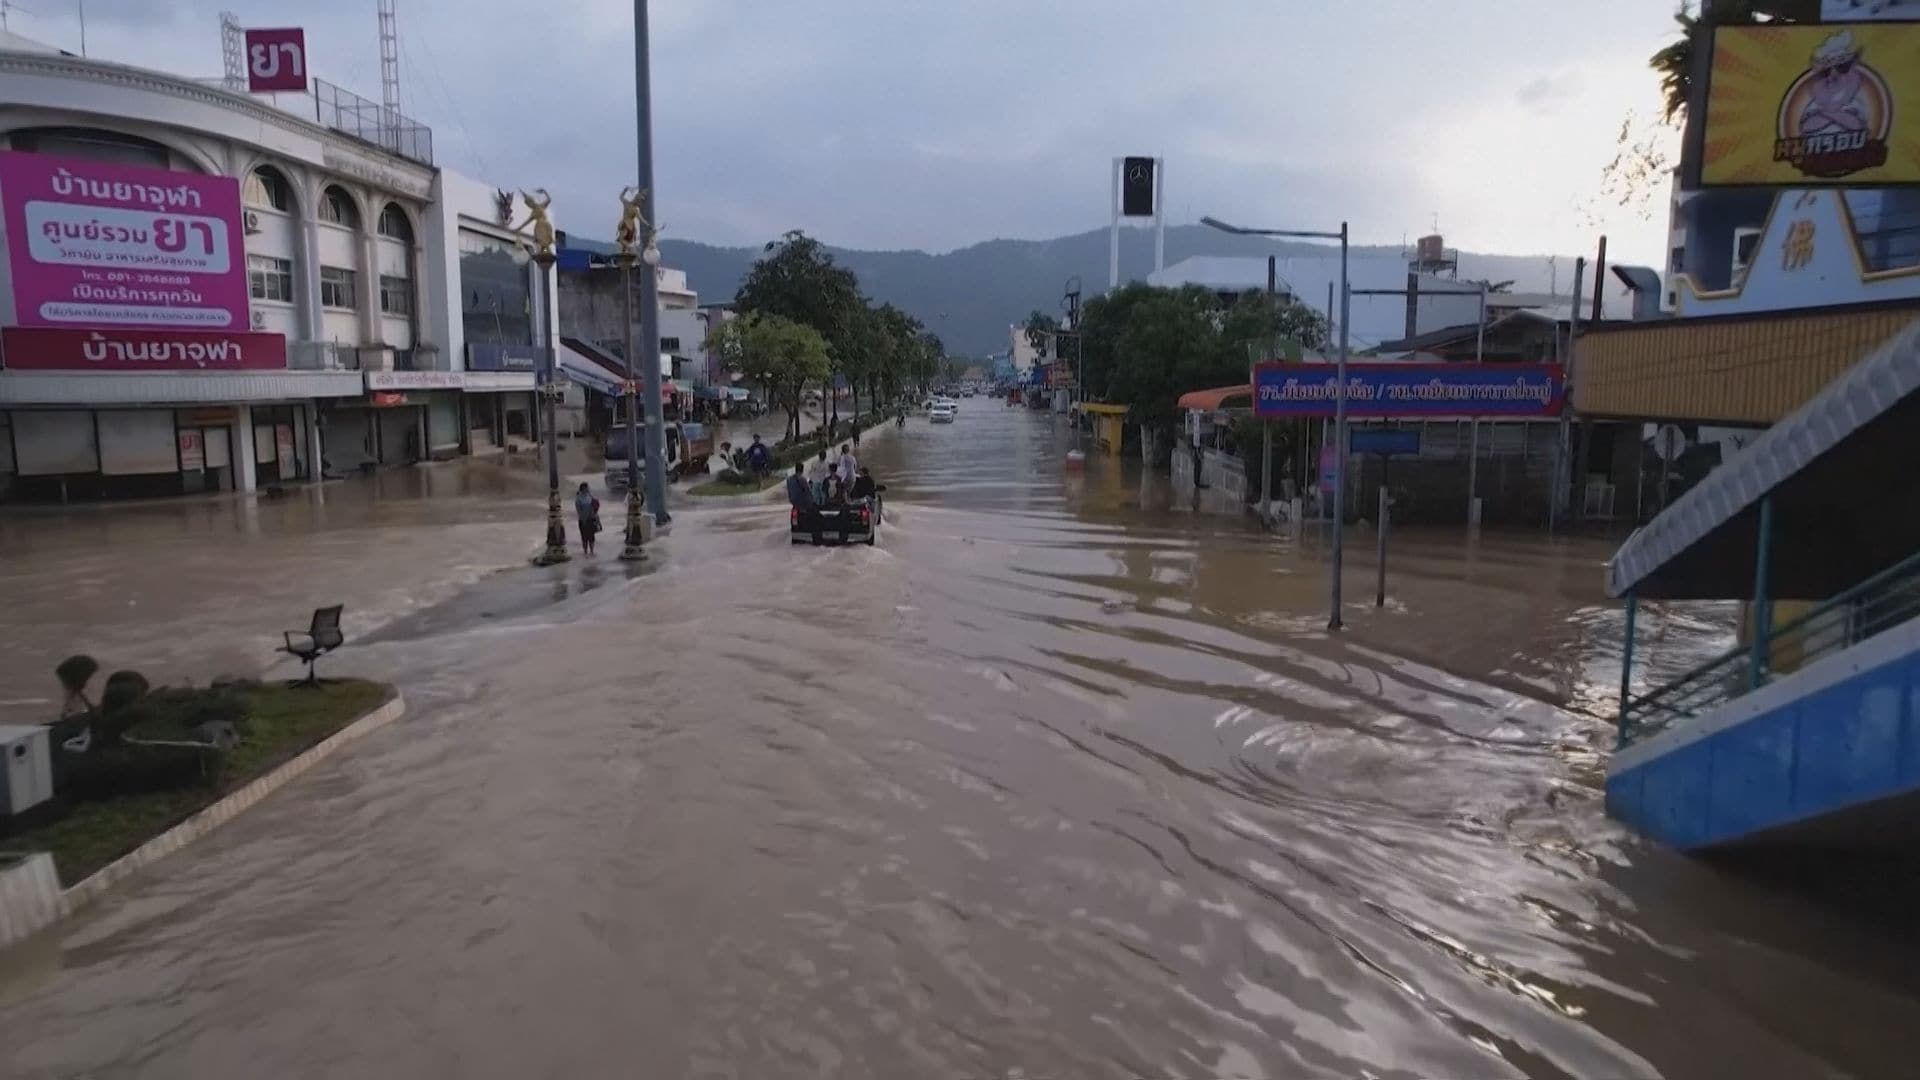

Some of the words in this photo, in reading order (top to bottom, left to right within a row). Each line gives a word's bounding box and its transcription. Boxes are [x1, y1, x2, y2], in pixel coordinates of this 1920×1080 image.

[251, 42, 302, 78] ยา
[52, 167, 201, 212] บ้านยาจุฬา
[72, 282, 202, 306] เปิดบริการทุกวัน
[82, 332, 242, 367] บ้านยาจุฬา
